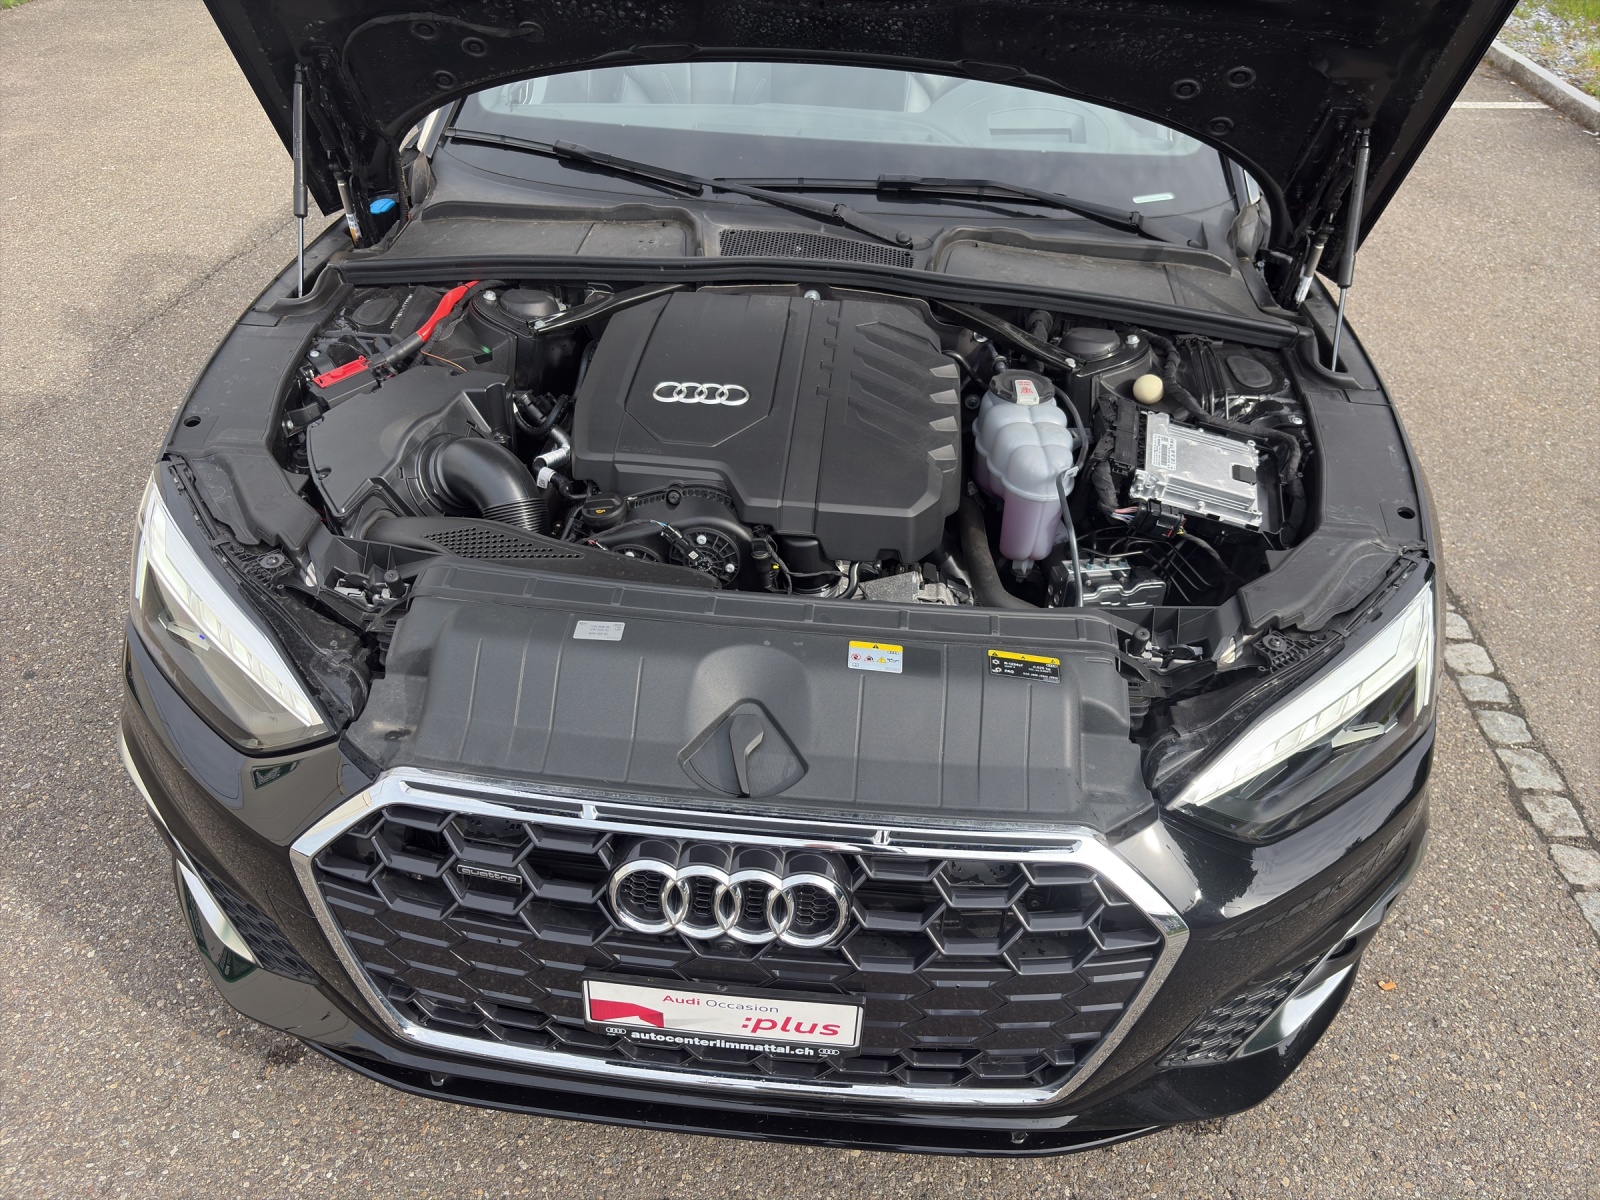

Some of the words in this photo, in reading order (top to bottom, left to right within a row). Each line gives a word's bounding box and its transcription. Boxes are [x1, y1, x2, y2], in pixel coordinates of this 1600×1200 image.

[461, 868, 517, 882] quattro
[662, 995, 701, 1006] Audi
[705, 999, 779, 1014] Occasion
[741, 1016, 841, 1036] :plus
[631, 1031, 814, 1056] autocenterlimmattal.ch
